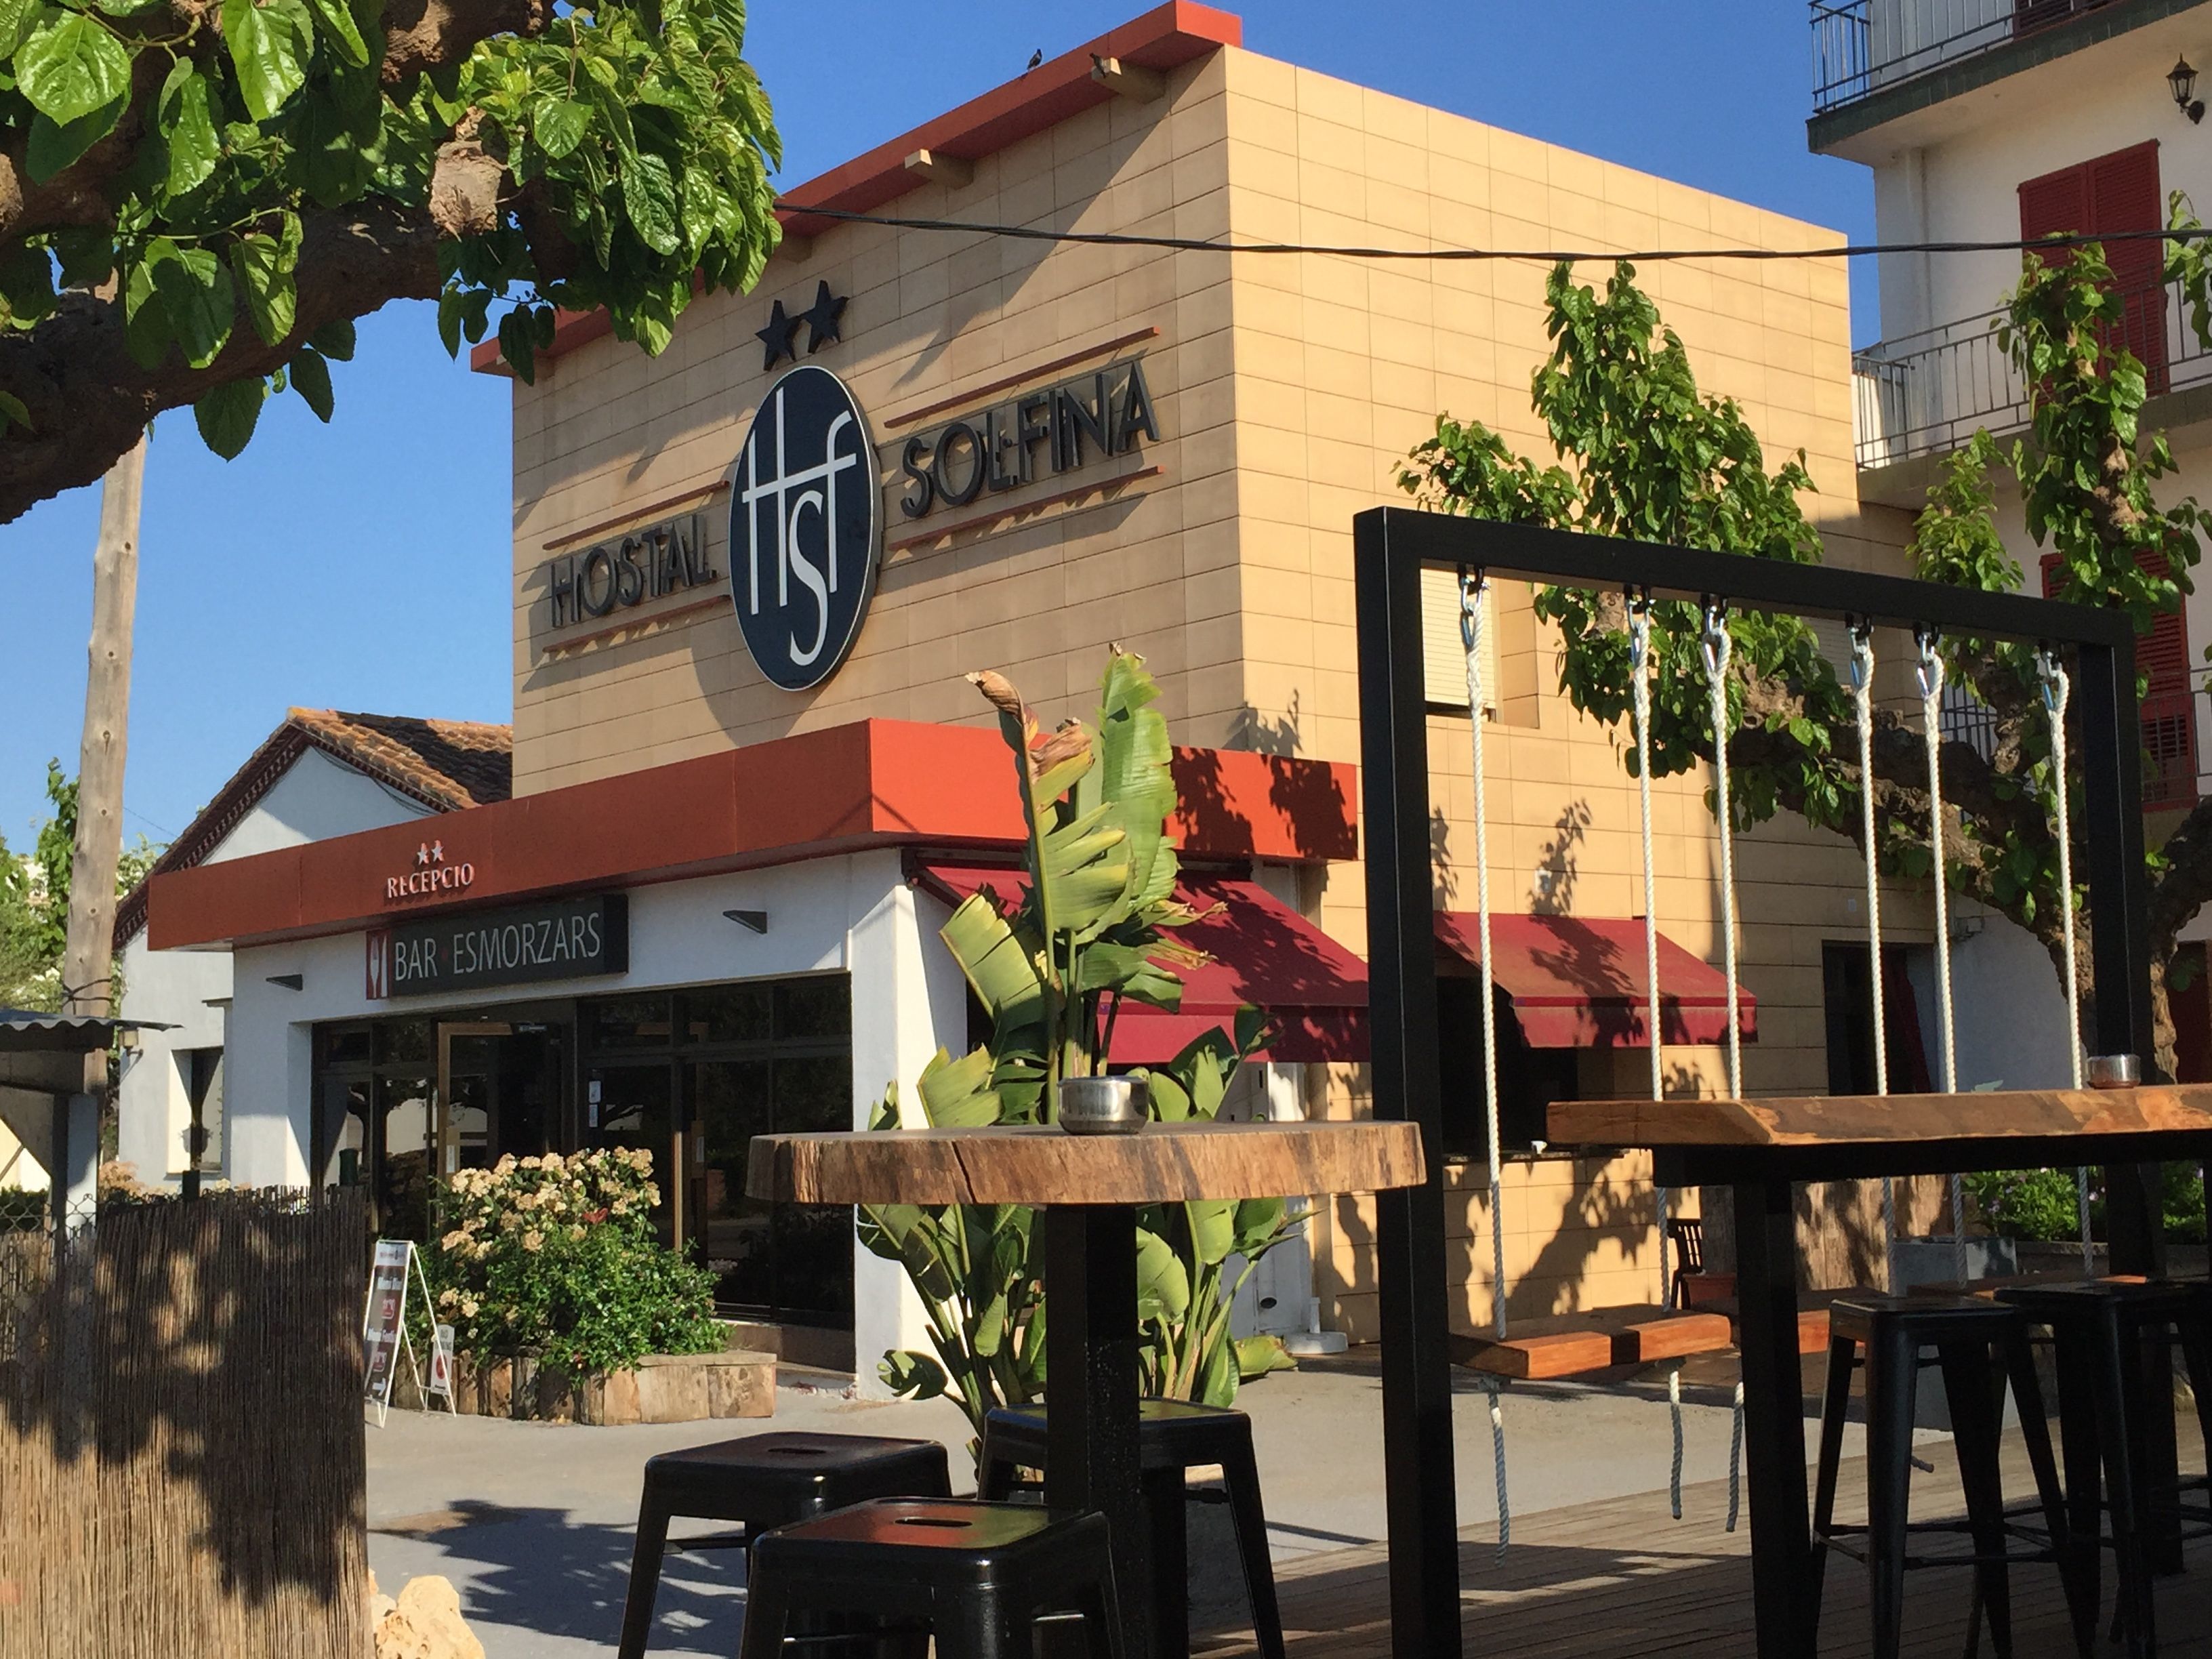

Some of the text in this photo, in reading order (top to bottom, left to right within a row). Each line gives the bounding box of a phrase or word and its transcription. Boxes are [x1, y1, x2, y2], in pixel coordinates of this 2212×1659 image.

[551, 359, 1161, 628] HOSTAL SOLFINA
[387, 863, 474, 899] RECEPCIO
[394, 912, 602, 982] BAR ESMORZARS
